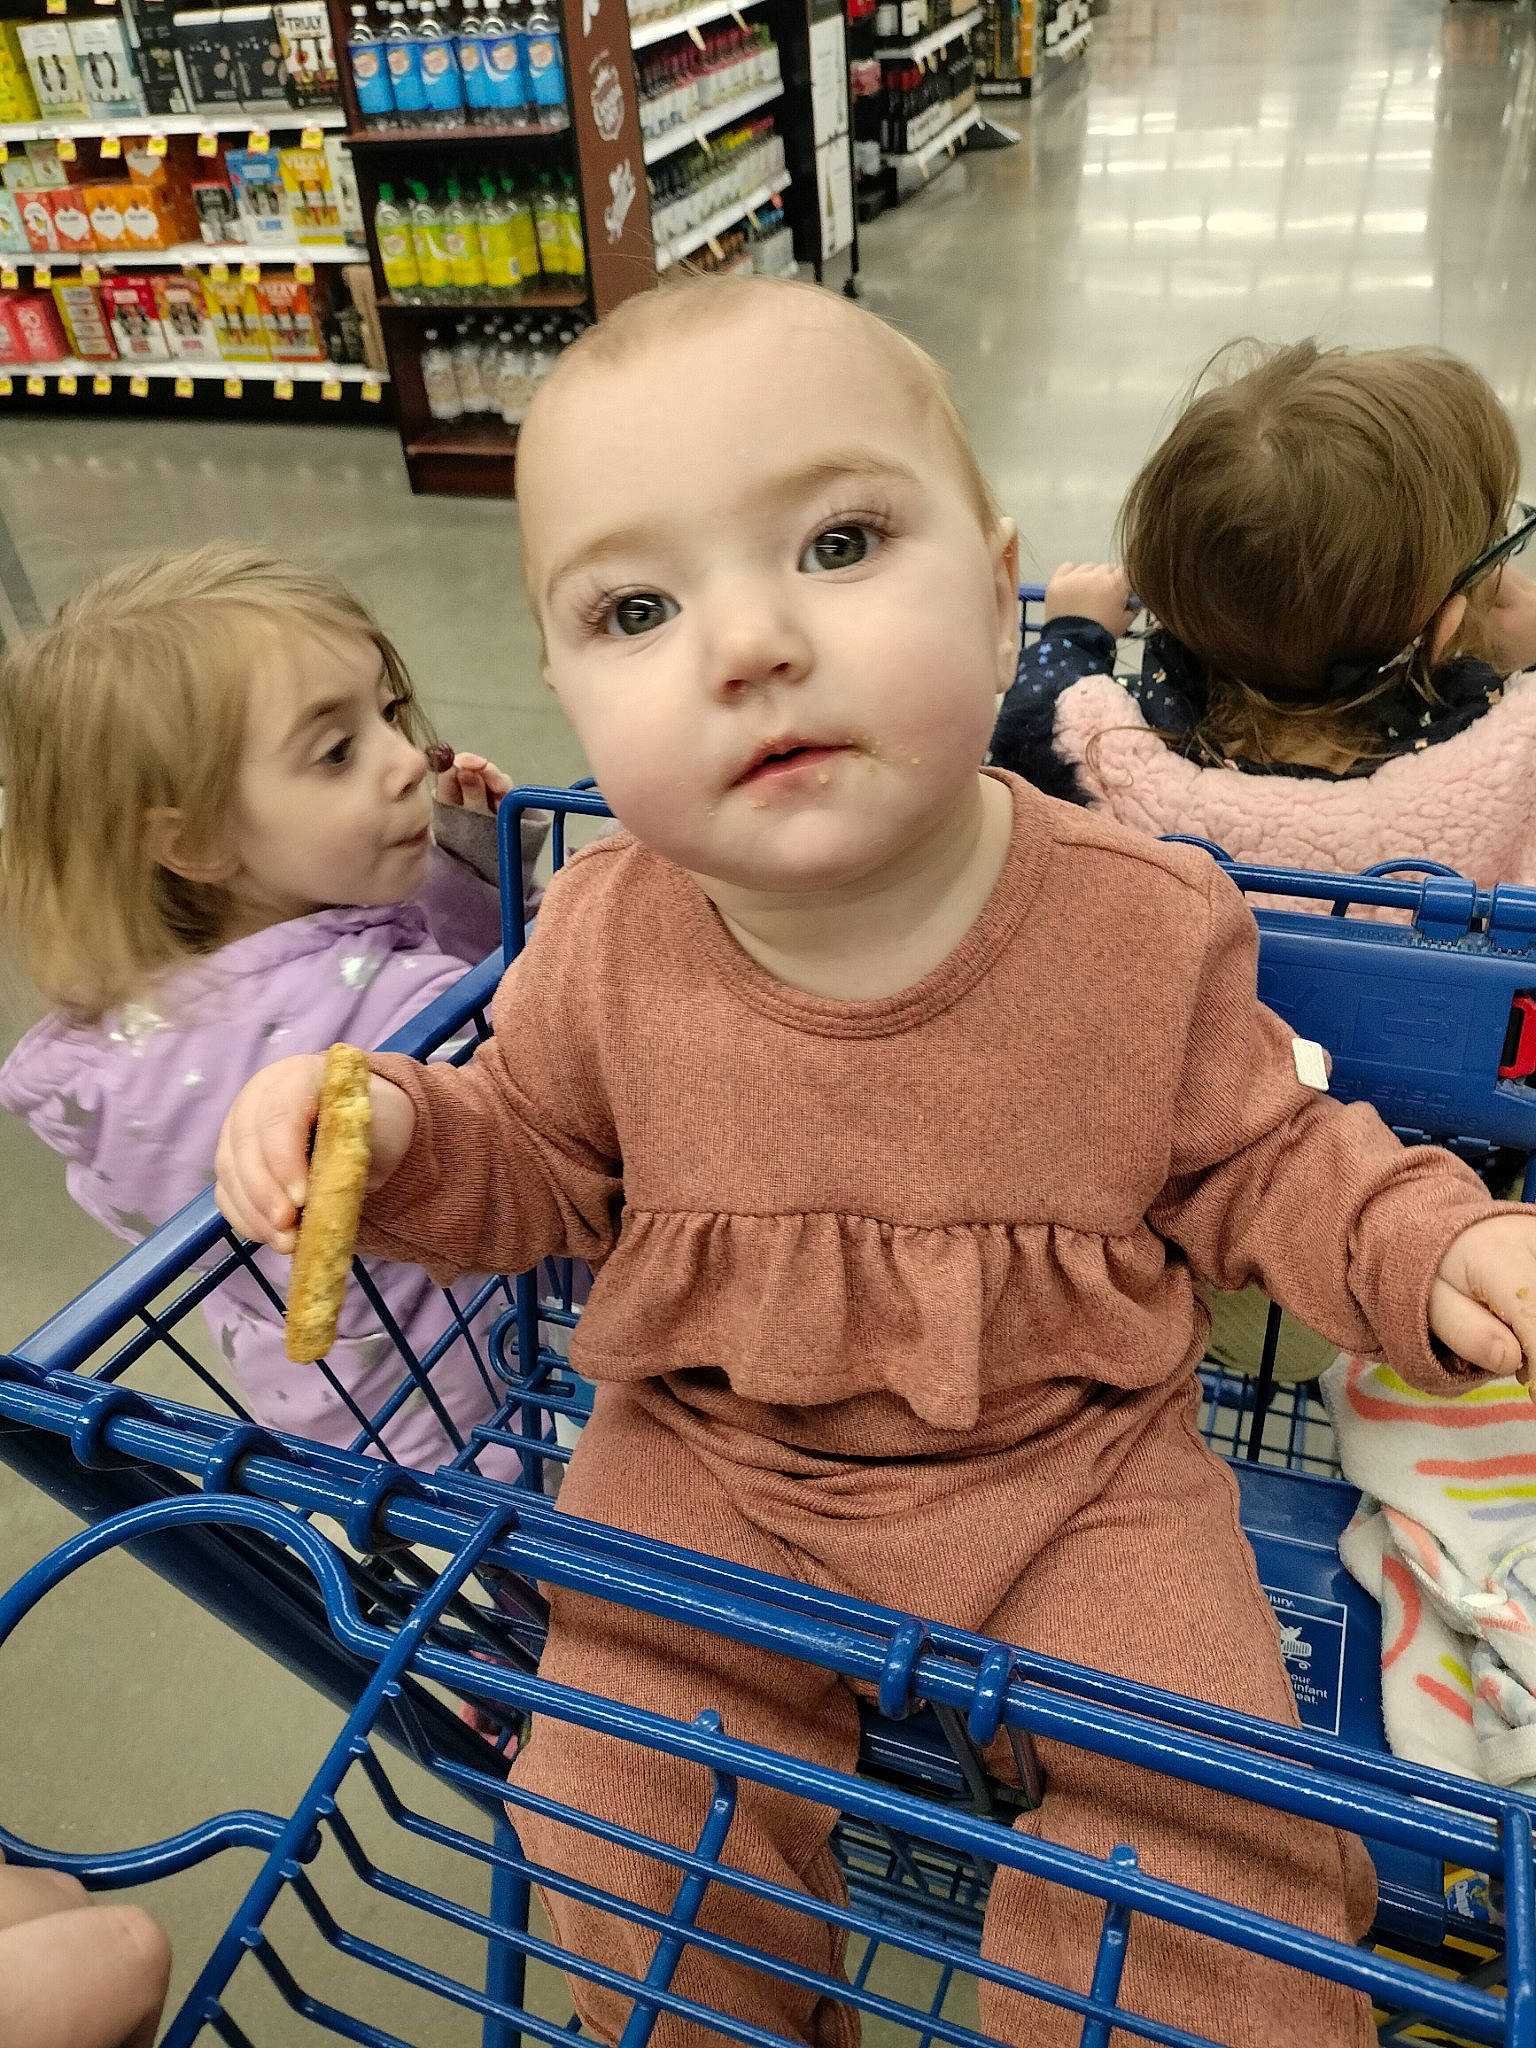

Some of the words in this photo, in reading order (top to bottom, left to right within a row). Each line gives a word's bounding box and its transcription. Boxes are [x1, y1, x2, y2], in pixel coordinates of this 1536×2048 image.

[286, 15, 322, 32] TRULY
[1268, 1594, 1296, 1608] jury.
[1291, 1673, 1312, 1685] our
[1294, 1684, 1328, 1699] infant
[1295, 1693, 1318, 1705] eat.
